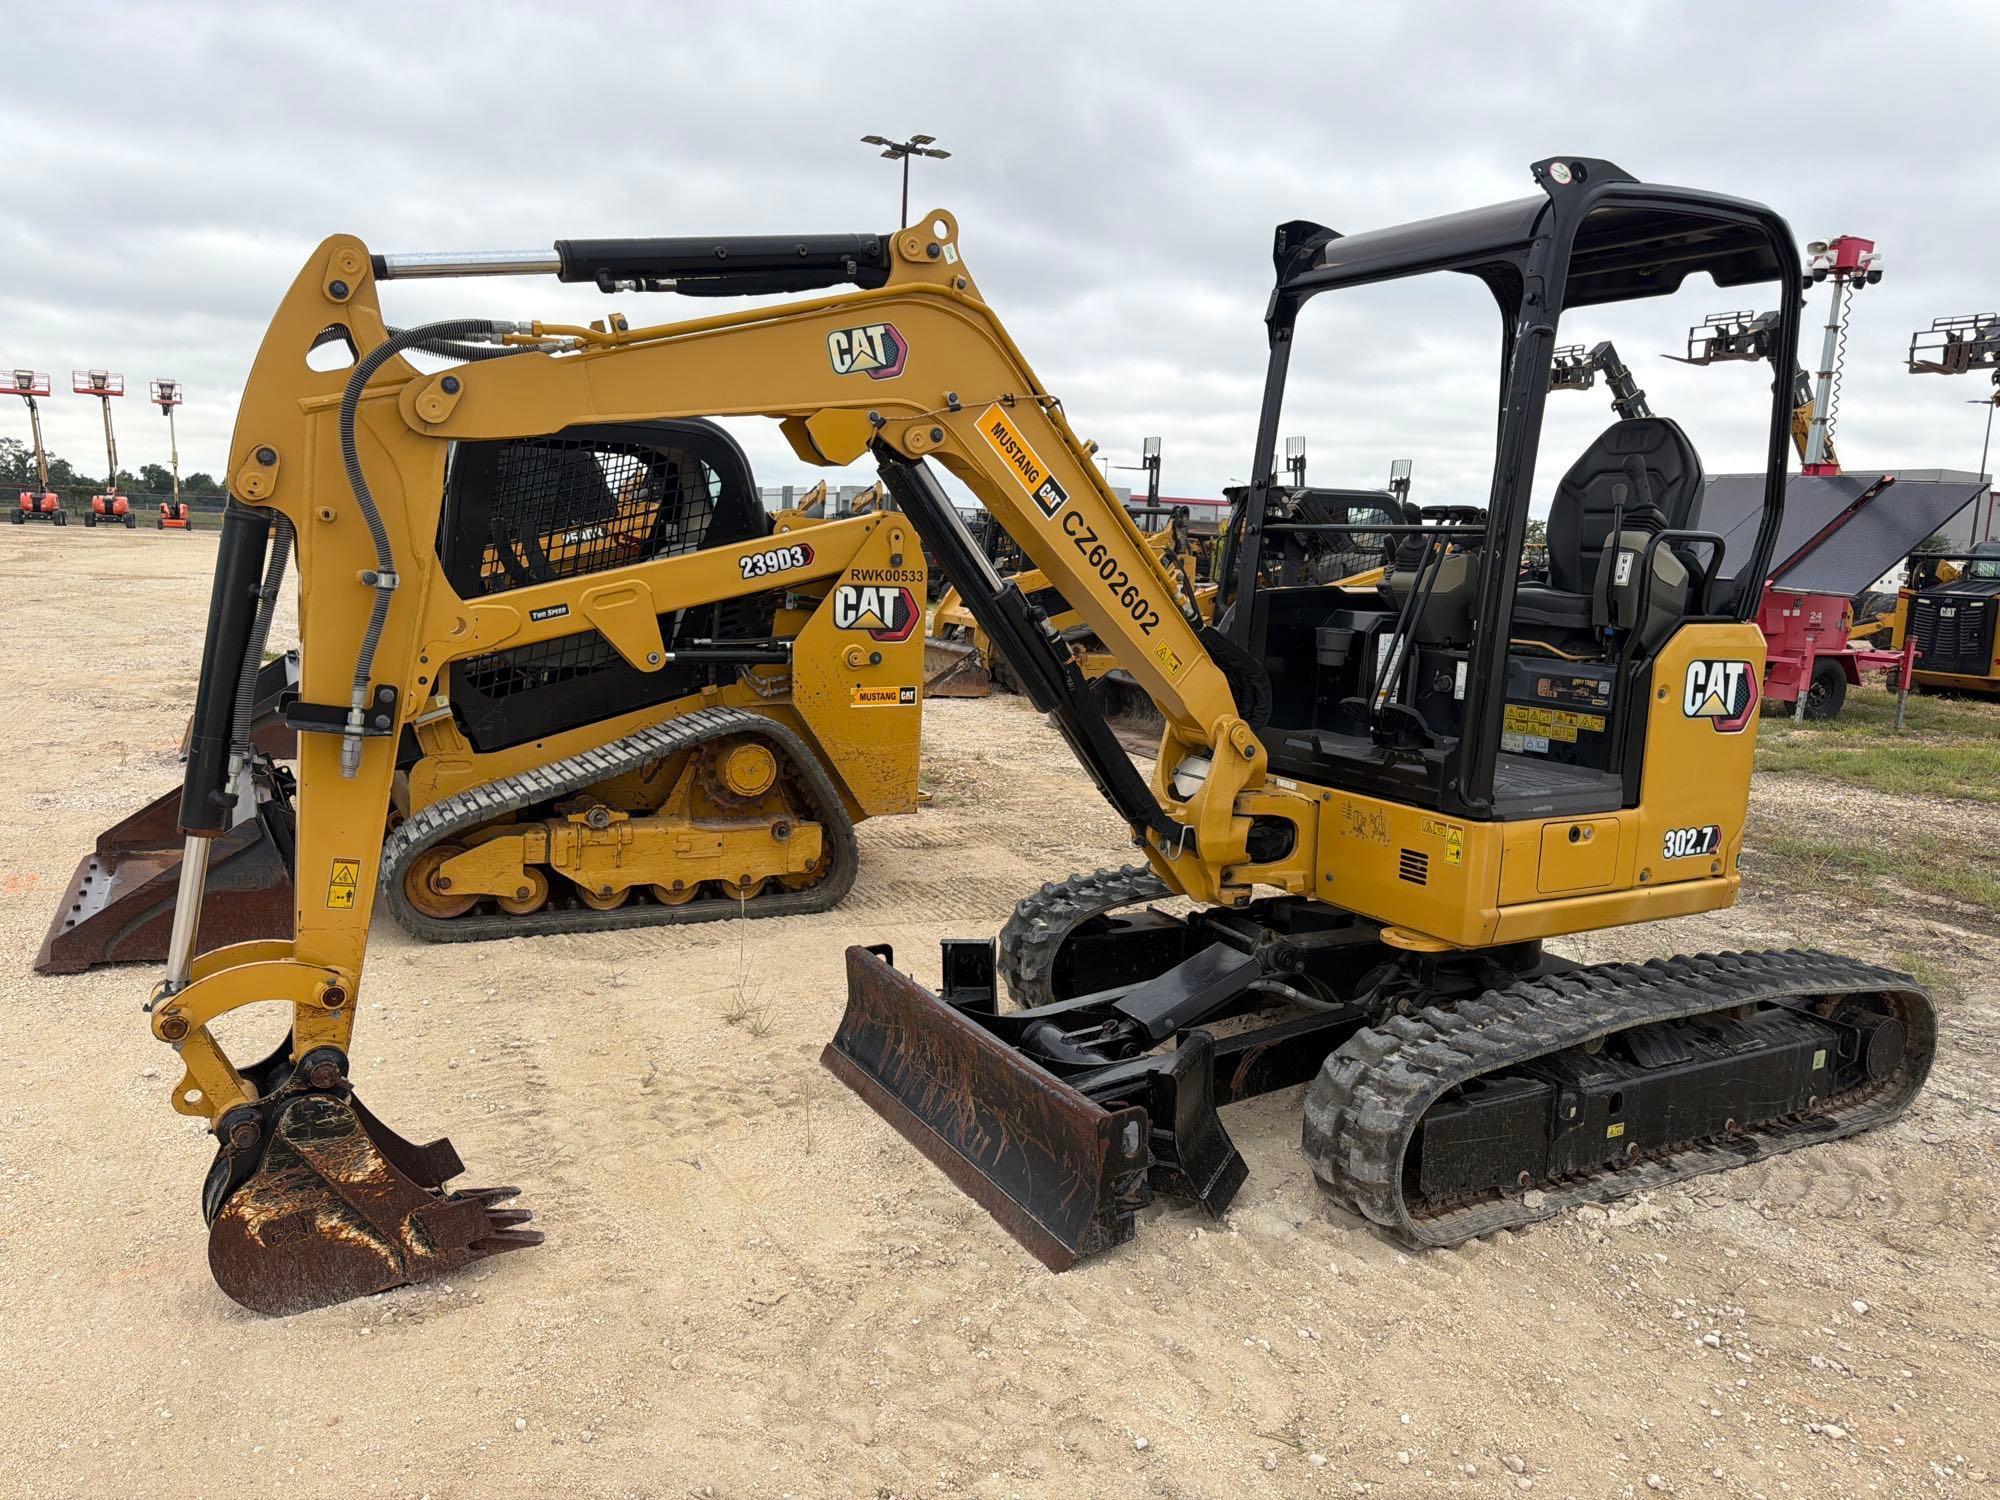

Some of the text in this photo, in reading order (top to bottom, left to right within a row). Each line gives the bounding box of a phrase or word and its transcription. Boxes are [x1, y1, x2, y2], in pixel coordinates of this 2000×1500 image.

[828, 325, 887, 373] CAT
[990, 421, 1062, 510] MUSTANG CAT
[740, 546, 804, 579] 239D3
[851, 569, 924, 582] RWK00533
[1062, 510, 1160, 637] CZ602602
[834, 585, 900, 630] CAT
[1940, 607, 1957, 617] CAT
[859, 690, 915, 702] MUSTANG CAT
[1683, 661, 1744, 716] CAT
[1664, 826, 1713, 858] 302.7
